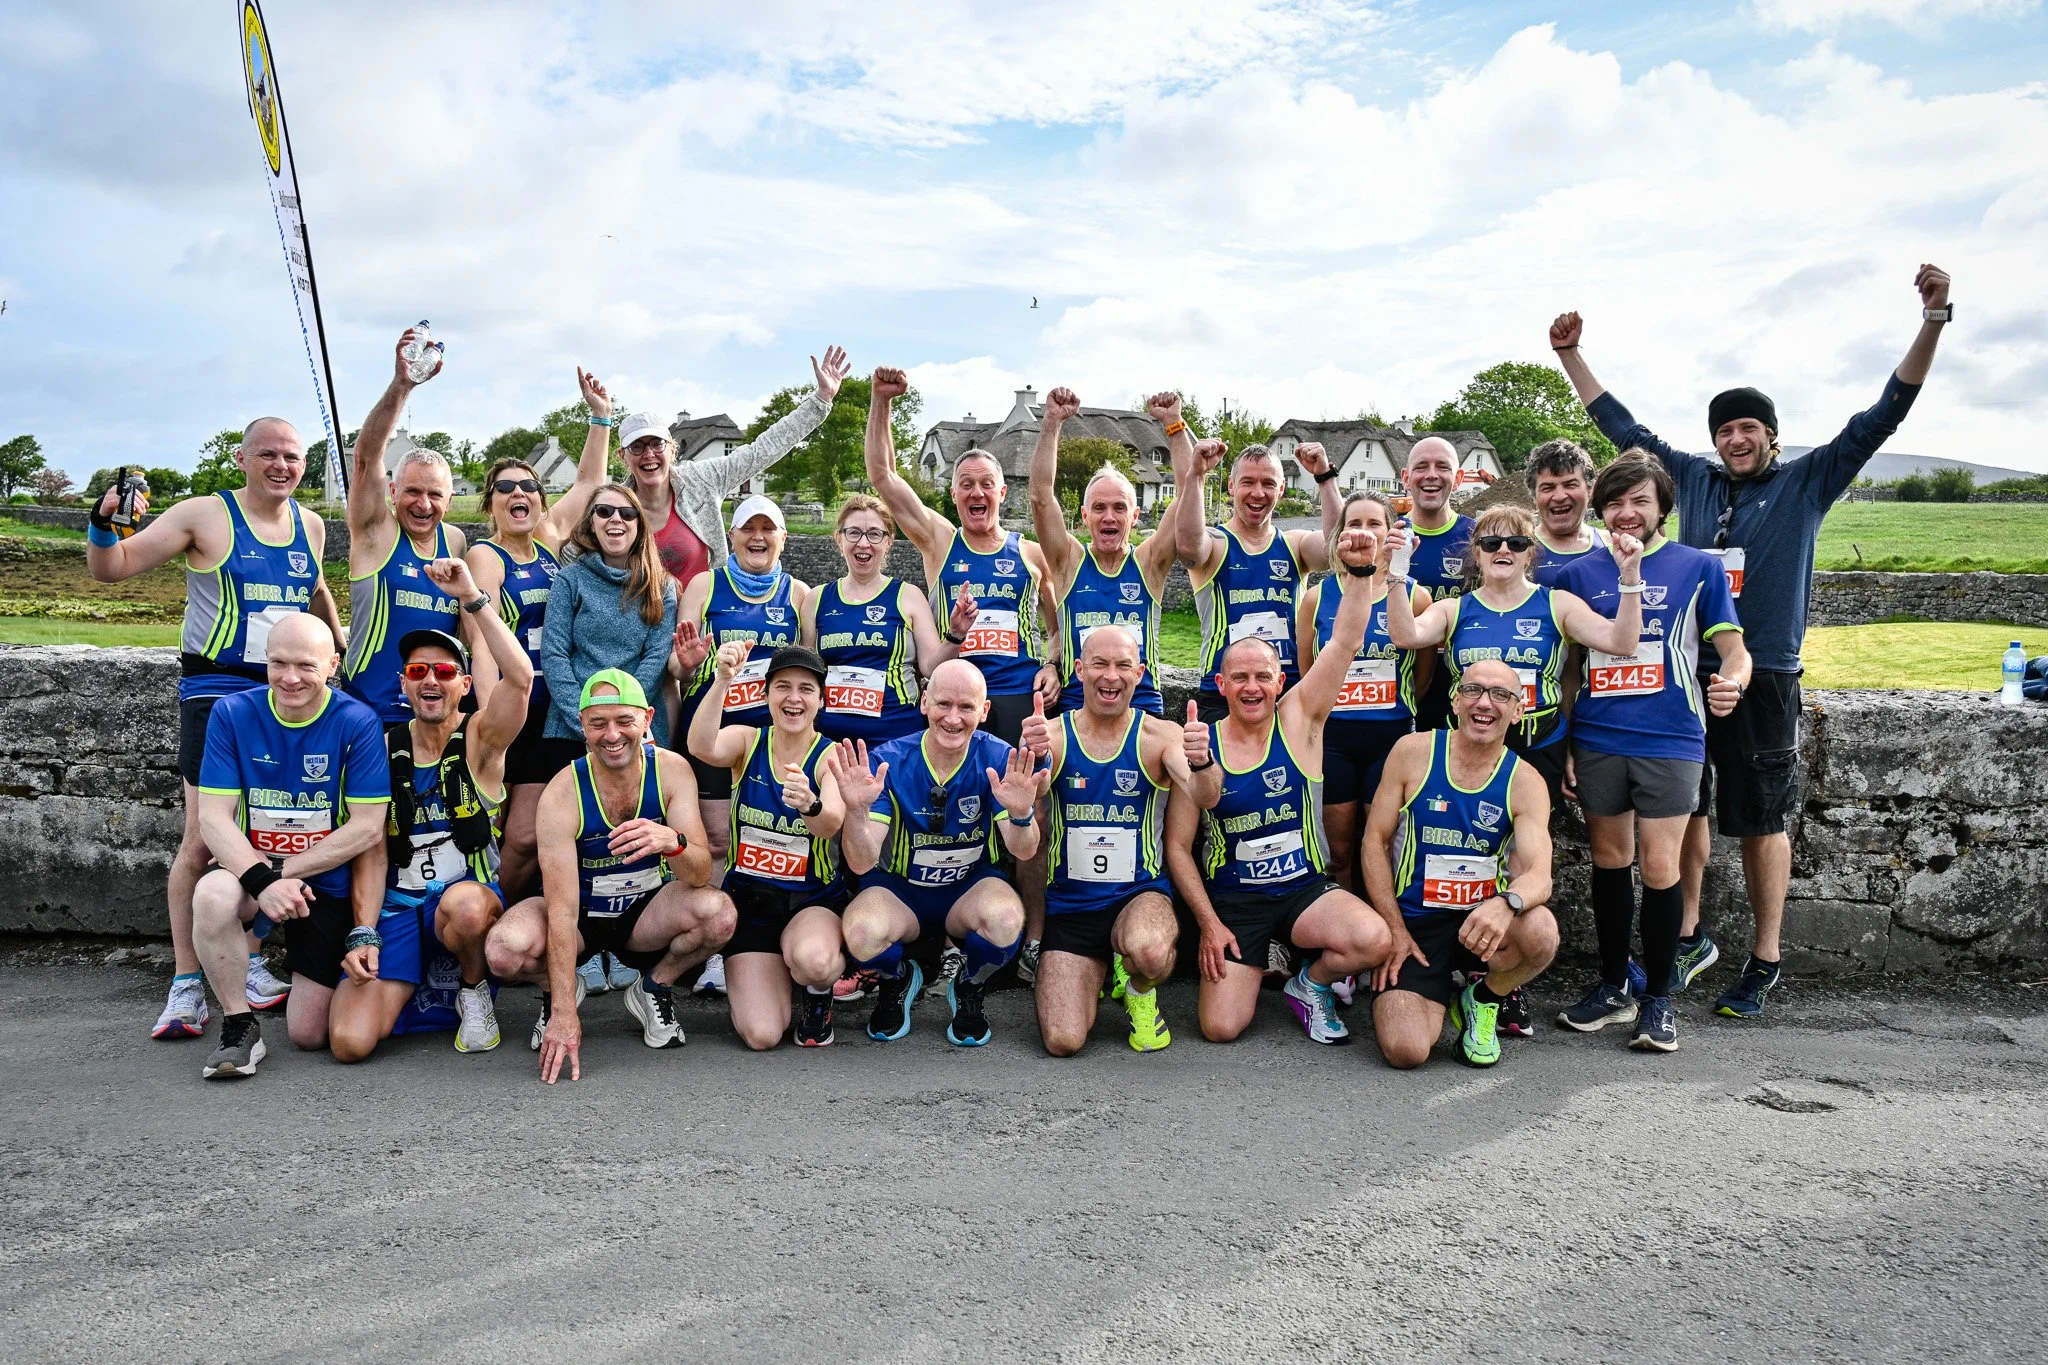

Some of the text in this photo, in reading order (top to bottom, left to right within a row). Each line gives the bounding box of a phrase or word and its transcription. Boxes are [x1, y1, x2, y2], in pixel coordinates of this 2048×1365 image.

[243, 582, 311, 604] BIRR A.C.
[395, 589, 433, 610] BIRR
[950, 583, 1017, 600] BRR A.C.
[1229, 587, 1293, 605] BIRR A.C.
[1075, 612, 1143, 627] BIRR A.C.
[720, 629, 759, 646] BIRR
[820, 632, 888, 650] BIRR A.C.
[964, 631, 1011, 649] 5125
[1366, 642, 1400, 660] A.C.
[1458, 647, 1542, 666] BIRR A.C.
[1595, 666, 1658, 690] 5445
[828, 688, 878, 709] 5468
[1336, 683, 1387, 704] 5431
[249, 787, 332, 809] BIRR A.C.
[739, 803, 809, 835] BIRR A.C.
[1066, 803, 1139, 822] BIRR A.C.
[1223, 802, 1297, 834] BIRR A.C.
[1422, 826, 1463, 848] BIRR
[420, 858, 437, 881] 6
[742, 847, 801, 875] 5297
[1093, 854, 1108, 874] 9
[1245, 853, 1297, 879] 1244
[920, 865, 970, 883] 1426
[1436, 881, 1484, 903] 5114
